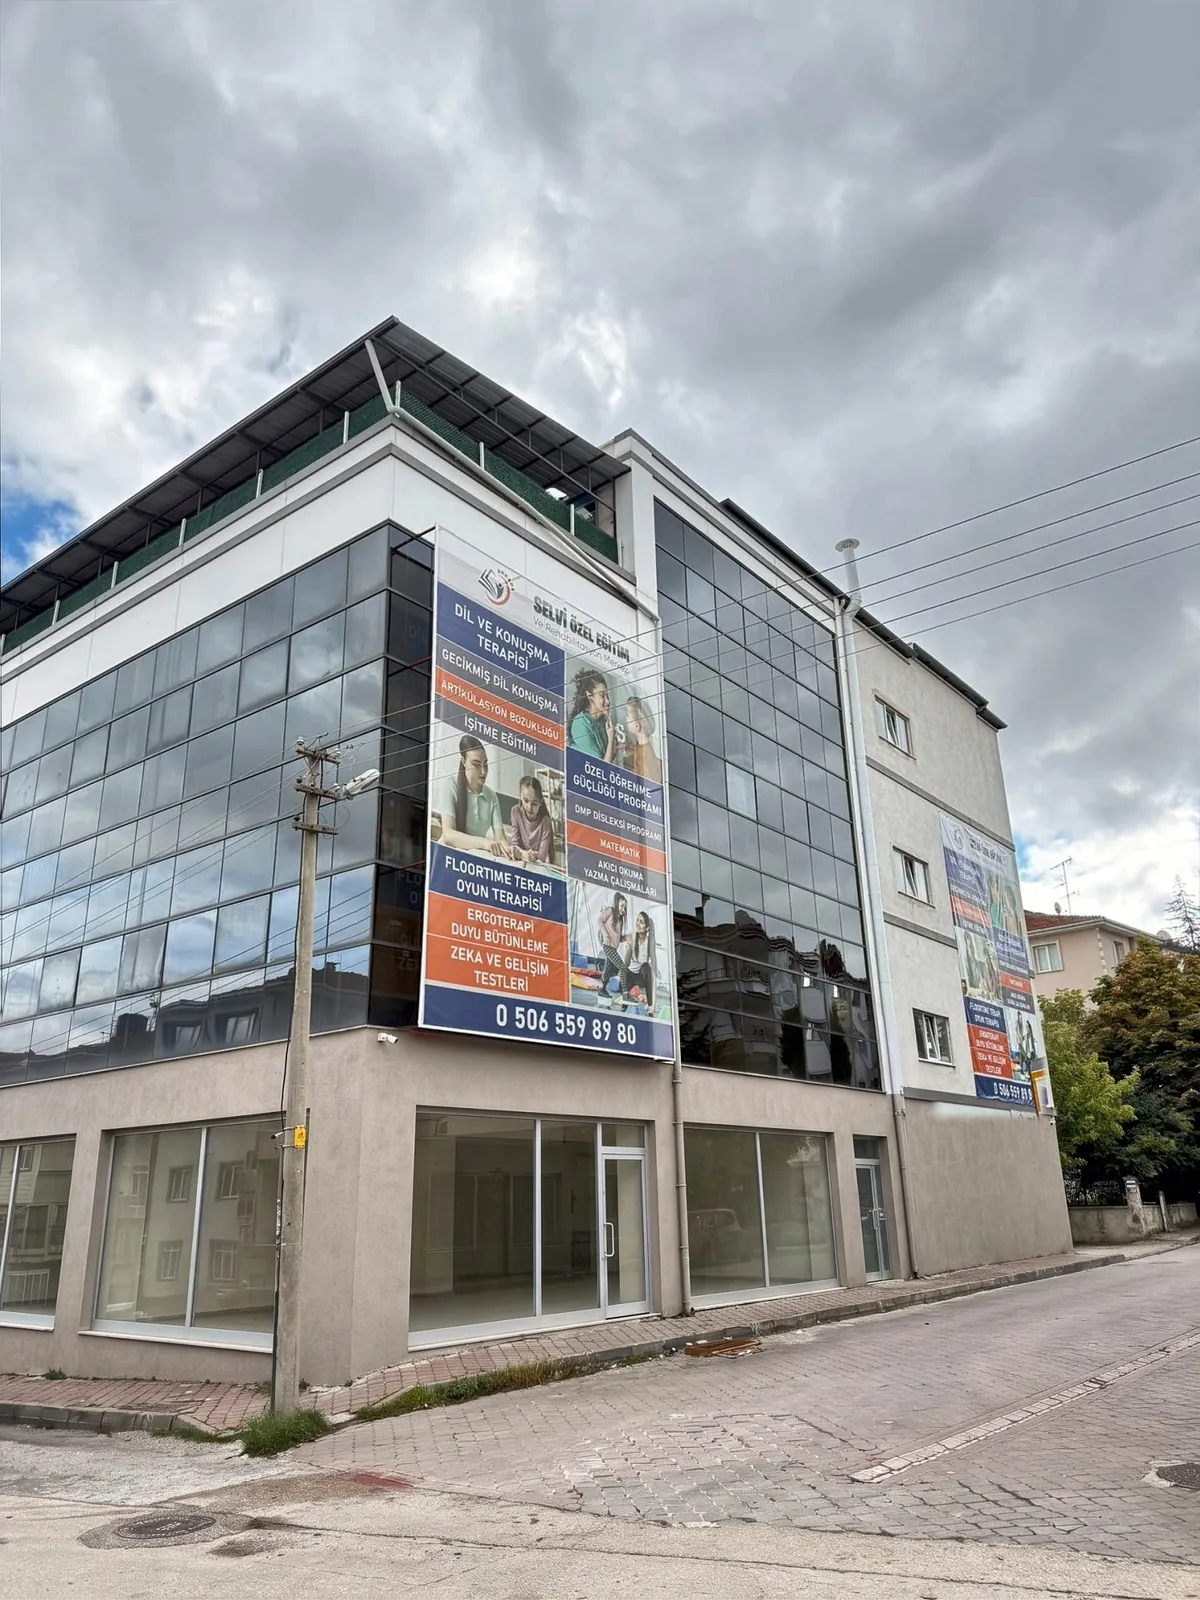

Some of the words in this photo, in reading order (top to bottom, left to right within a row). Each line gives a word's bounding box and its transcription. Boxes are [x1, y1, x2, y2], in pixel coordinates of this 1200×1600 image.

[455, 603, 474, 625] DİL
[477, 615, 493, 634] VE
[496, 626, 551, 665] KONUŞMA
[533, 596, 567, 628] SELVİ
[570, 614, 594, 643] ÖZEL
[477, 634, 529, 671] TERAPİSİ
[442, 648, 490, 684] GECİKMİŞ
[493, 674, 509, 692] DİL
[512, 684, 558, 714] KONUŞMA
[501, 732, 537, 756] EĞİTİMİ
[573, 774, 616, 799] GÜÇLÜĞÜ
[618, 791, 662, 817] PROGRAMI
[584, 760, 608, 781] ÖZEL
[610, 771, 652, 799] ÖĞRENME
[574, 804, 592, 817] DMP
[593, 810, 626, 830] DİSLEKSİ
[627, 823, 662, 843] PROGRAMI
[600, 838, 640, 859] MATEMATİK
[445, 855, 512, 886] FLOORTIME
[514, 875, 552, 897] TERAPİ
[584, 867, 609, 883] YAZMA
[610, 875, 657, 897] ÇALIŞMALARI
[598, 859, 618, 873] AKICI
[619, 866, 644, 881] OKUMA
[456, 879, 489, 899] OYUN
[491, 888, 543, 912] TERAPİSİ
[467, 907, 534, 934] ERGOTERAPİ
[451, 922, 481, 940] DUYU
[484, 928, 549, 955] BÜTÜNLEME
[450, 945, 483, 965] ZEKA
[486, 952, 501, 968] VE
[504, 957, 549, 977] GELİŞİM
[474, 970, 529, 992] TESTLERİ
[496, 1003, 508, 1027] 0
[515, 1006, 549, 1032] 506
[555, 1011, 586, 1037] 559
[592, 1019, 612, 1041] 89
[617, 1024, 637, 1045] 80
